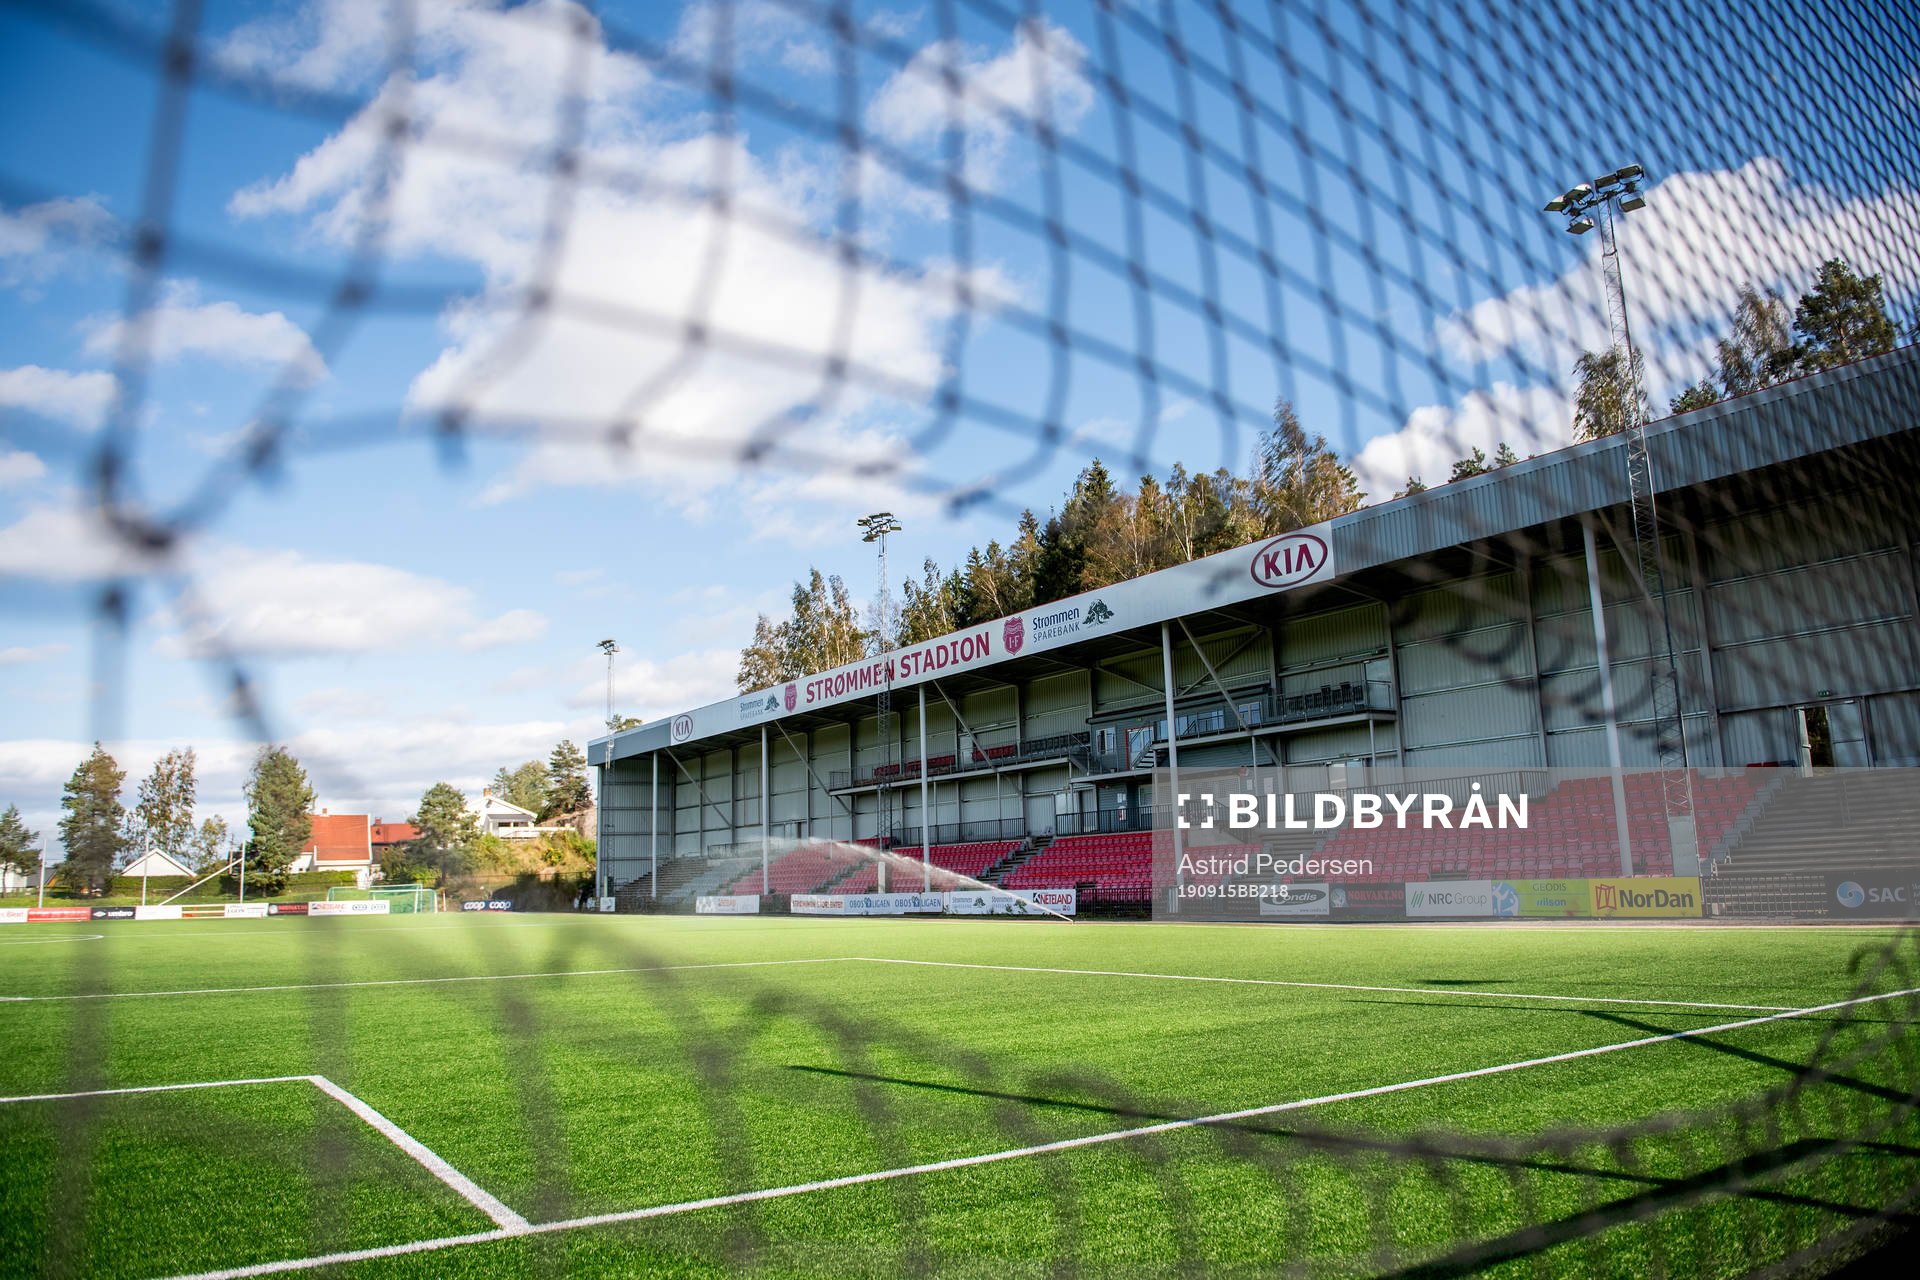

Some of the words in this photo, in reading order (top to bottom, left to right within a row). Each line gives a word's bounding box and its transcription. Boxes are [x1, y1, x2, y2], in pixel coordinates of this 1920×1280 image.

[1263, 543, 1315, 580] KIA
[1032, 607, 1080, 631] Strømmen
[1033, 620, 1081, 643] SPAREBANK
[806, 658, 895, 703] STRØMMEN
[900, 631, 990, 678] STADION
[675, 719, 690, 737] KIA
[1532, 882, 1567, 892] GEODIS
[1868, 886, 1907, 903] SAC
[849, 899, 864, 908] OBOS
[894, 898, 911, 907] OBOS
[920, 897, 941, 907] LIGAEN
[1428, 894, 1453, 905] NRC
[1454, 894, 1487, 907] Group
[1619, 889, 1694, 908] NorDan
